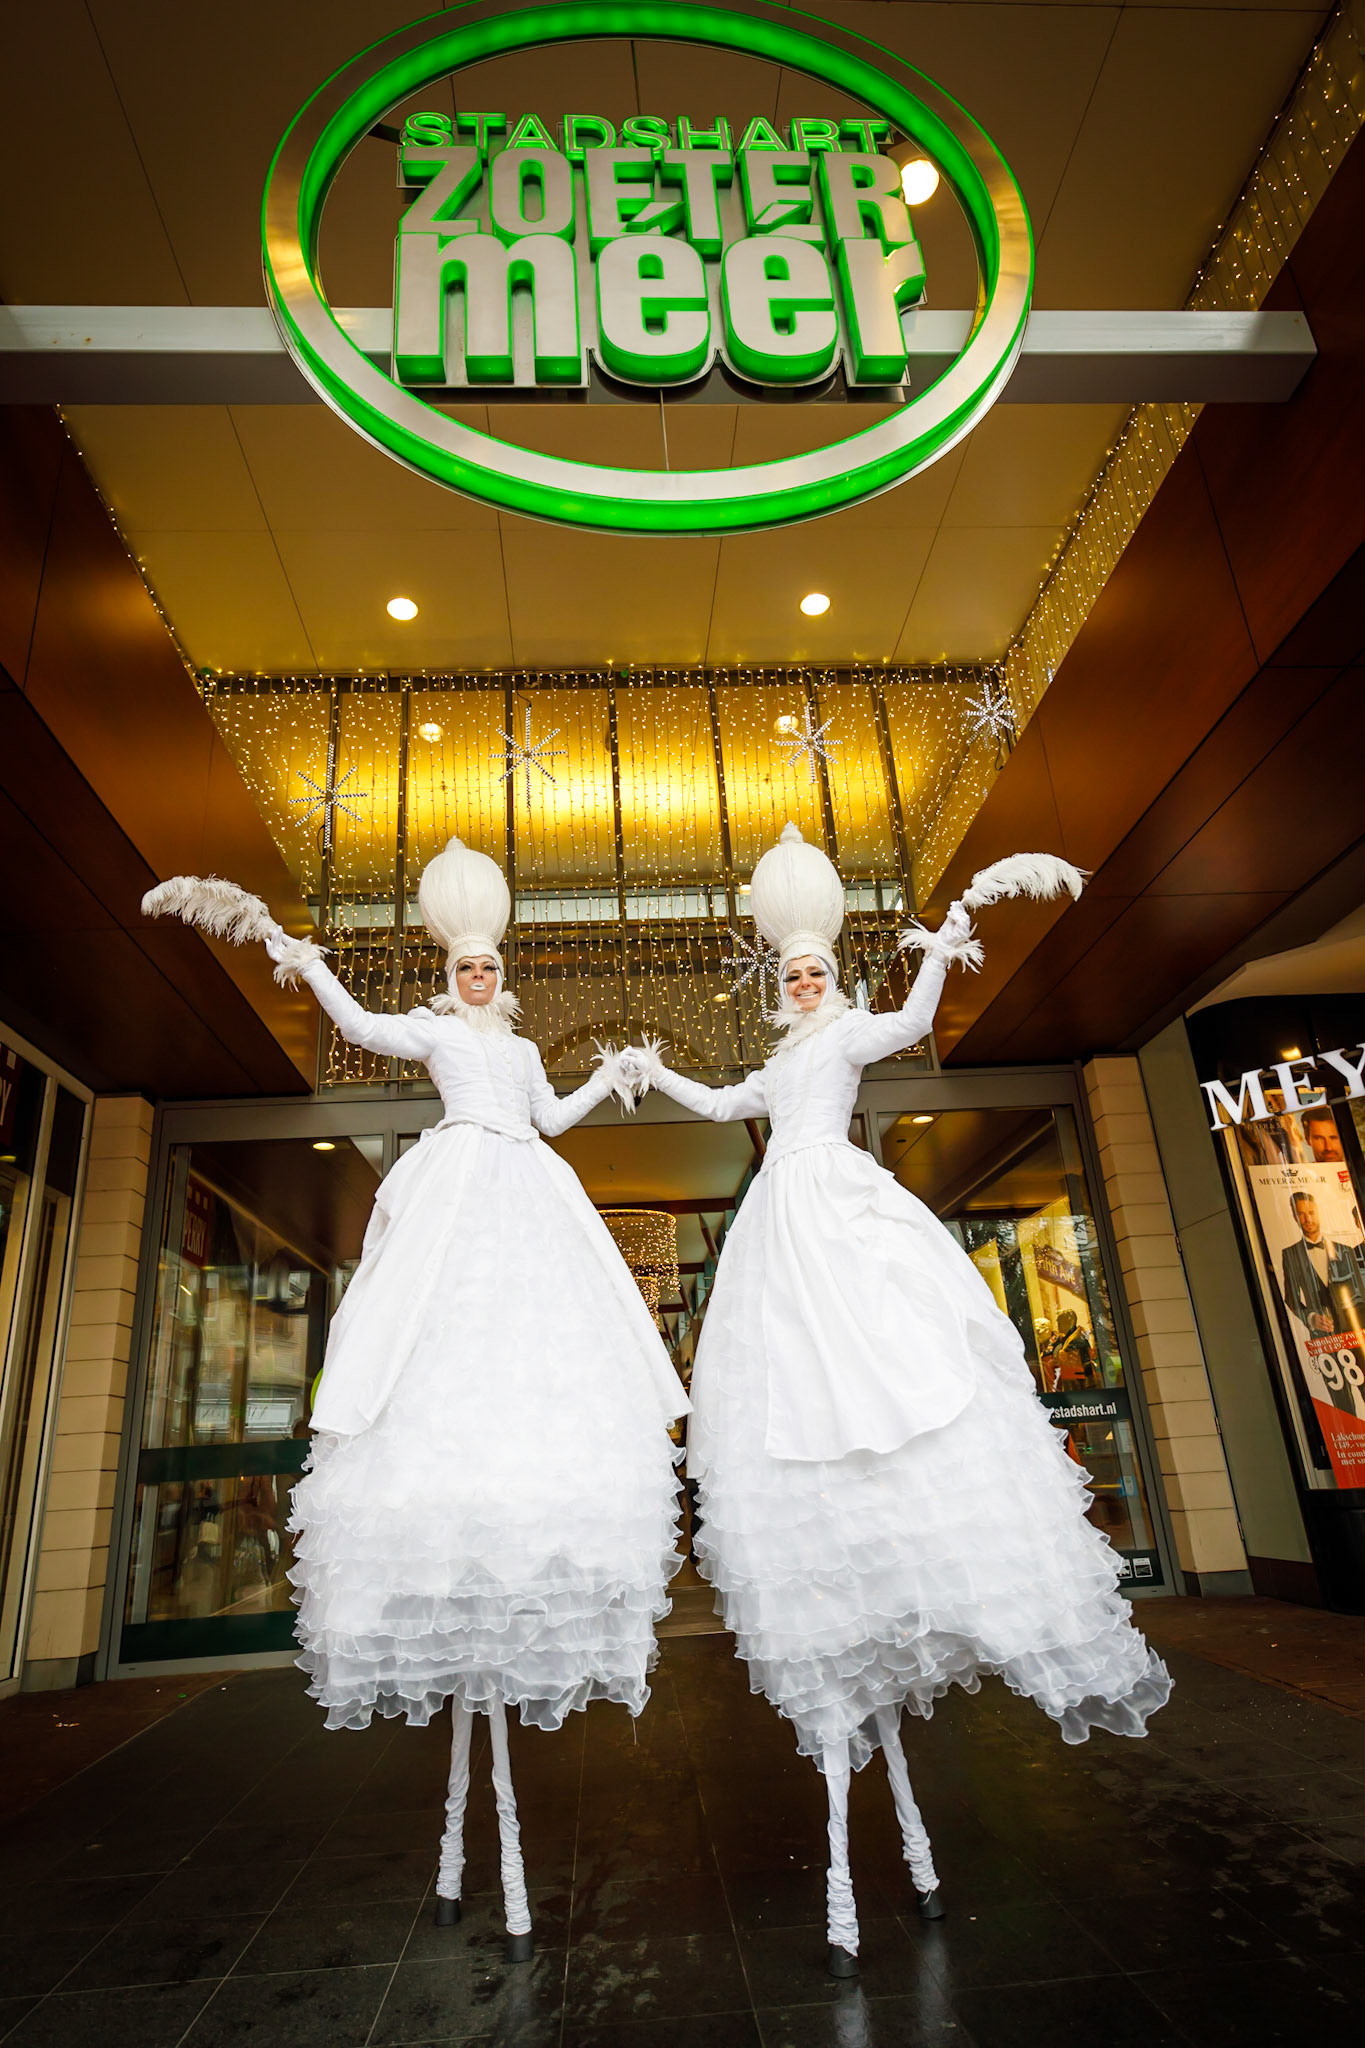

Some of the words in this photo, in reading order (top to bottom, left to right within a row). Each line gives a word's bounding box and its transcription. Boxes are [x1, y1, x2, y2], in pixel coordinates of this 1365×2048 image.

[403, 111, 894, 160] STADSHART
[399, 146, 918, 258] ZOETER
[1200, 1042, 1365, 1131] MEY
[1258, 1177, 1288, 1186] MEYER
[1308, 1336, 1345, 1348] Smoking
[1317, 1348, 1365, 1391] 98
[1336, 1450, 1347, 1459] In
